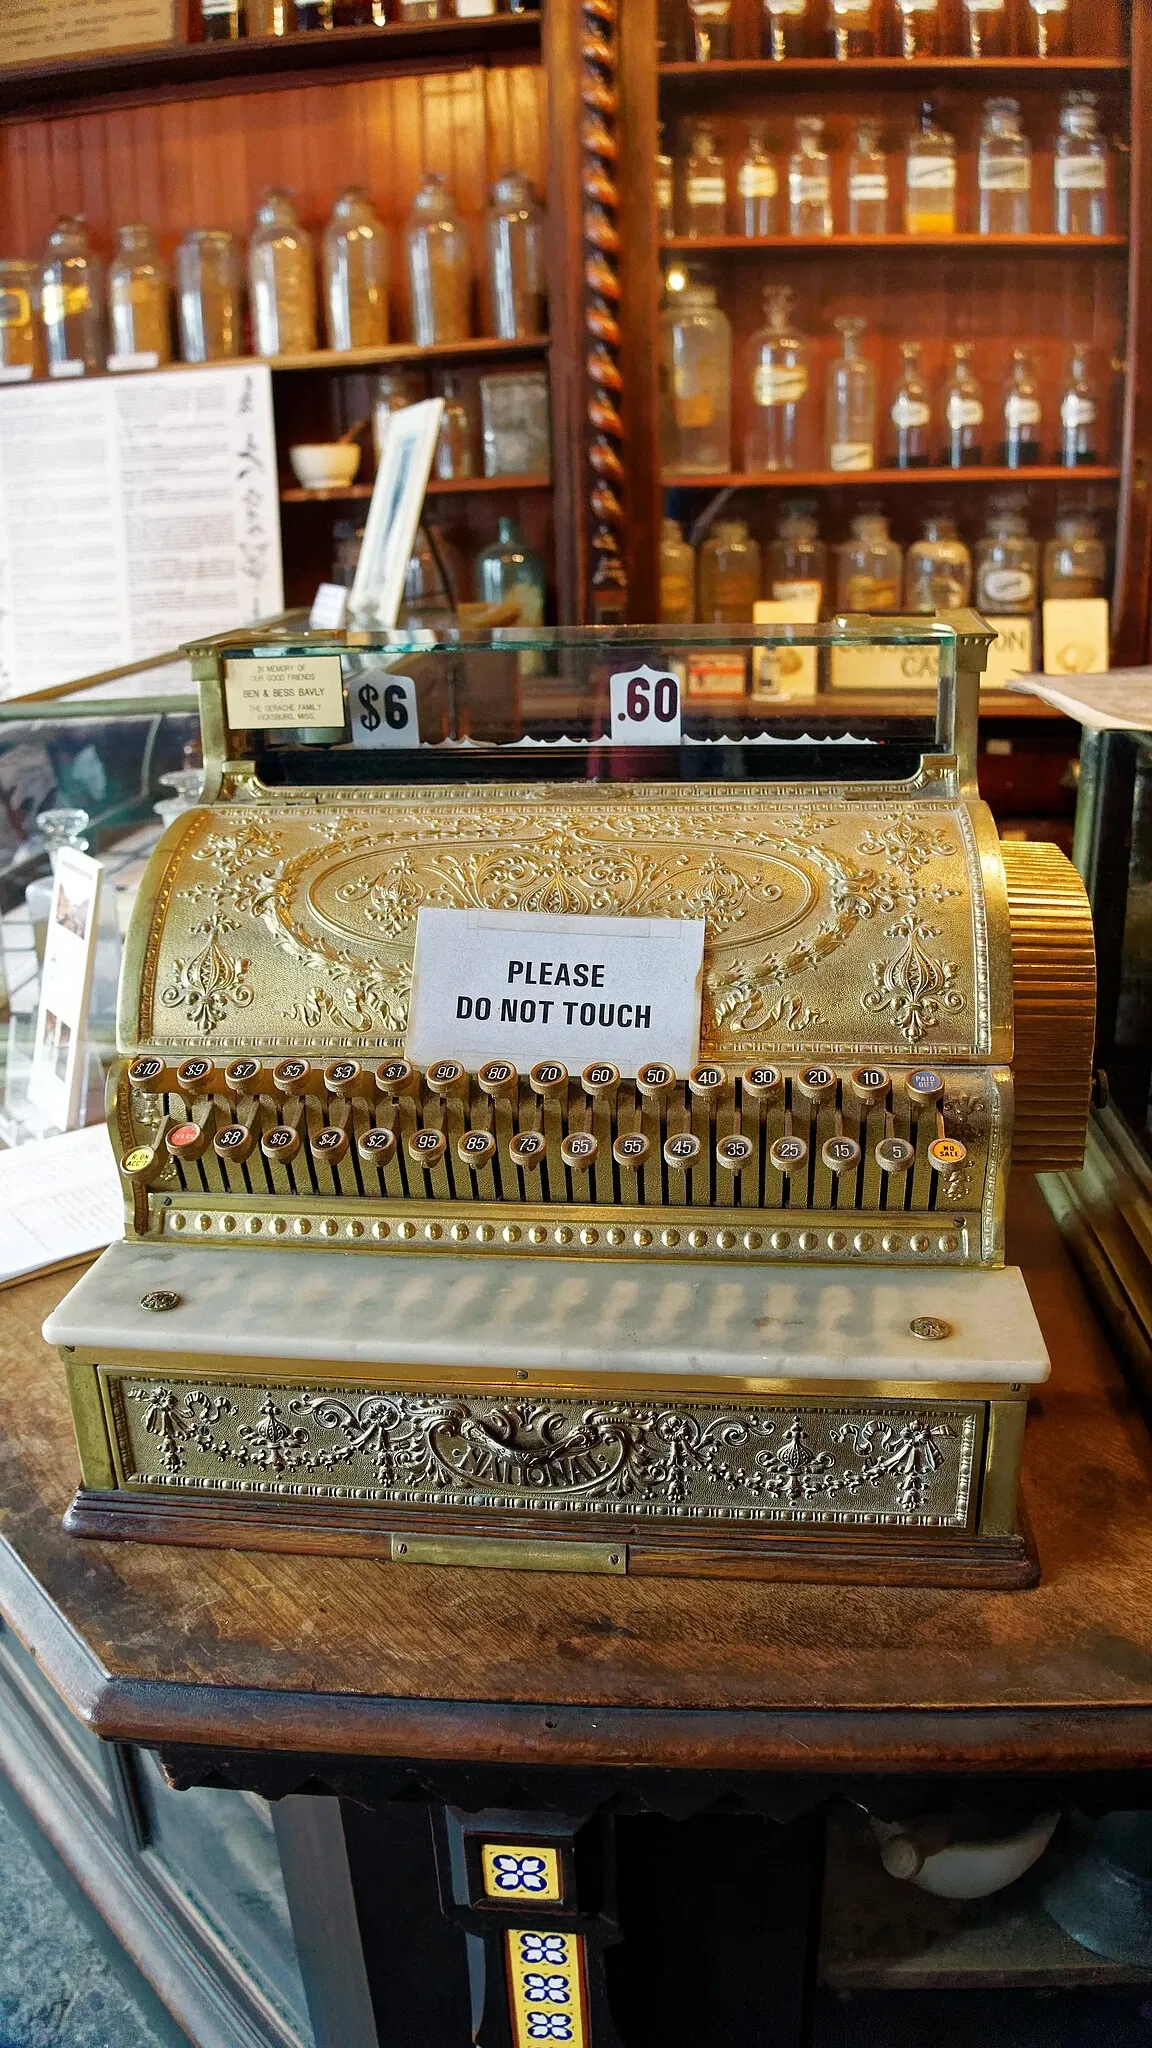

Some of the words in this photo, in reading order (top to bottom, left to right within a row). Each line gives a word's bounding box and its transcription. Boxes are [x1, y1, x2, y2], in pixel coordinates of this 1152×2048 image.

[243, 689, 259, 698] BEN
[273, 689, 294, 697] BESS
[298, 688, 325, 697] BAVLY
[618, 677, 678, 722] .60
[358, 684, 408, 732] $6
[508, 960, 605, 988] PLEASE
[456, 996, 491, 1021] DO
[500, 999, 554, 1024] NOT
[563, 1002, 651, 1028] TOUCH
[134, 1062, 160, 1075] $10
[186, 1064, 205, 1076] $9
[234, 1064, 253, 1076] $7
[283, 1064, 302, 1077] $5
[334, 1066, 353, 1078] $3
[386, 1066, 403, 1078] $1
[436, 1066, 456, 1078] 90
[488, 1067, 508, 1080] 80
[540, 1068, 558, 1080] 70
[591, 1069, 610, 1082] 60
[646, 1070, 665, 1082] 50
[698, 1071, 717, 1084] 40
[754, 1070, 772, 1083] 30
[809, 1071, 826, 1083] 20
[864, 1072, 880, 1085] 10
[220, 1131, 240, 1145] $8
[270, 1133, 288, 1145] $6
[319, 1134, 337, 1146] $4
[367, 1135, 386, 1148] $2
[417, 1135, 438, 1148] 95
[466, 1137, 486, 1150] 85
[519, 1138, 539, 1151] 75
[571, 1140, 589, 1153] 65
[624, 1140, 642, 1153] 55
[672, 1141, 691, 1153] 45
[727, 1143, 745, 1156] 35
[781, 1144, 799, 1157] 25
[834, 1145, 850, 1157] 15
[892, 1146, 901, 1158] 5
[457, 1446, 607, 1487] NATIONAL
